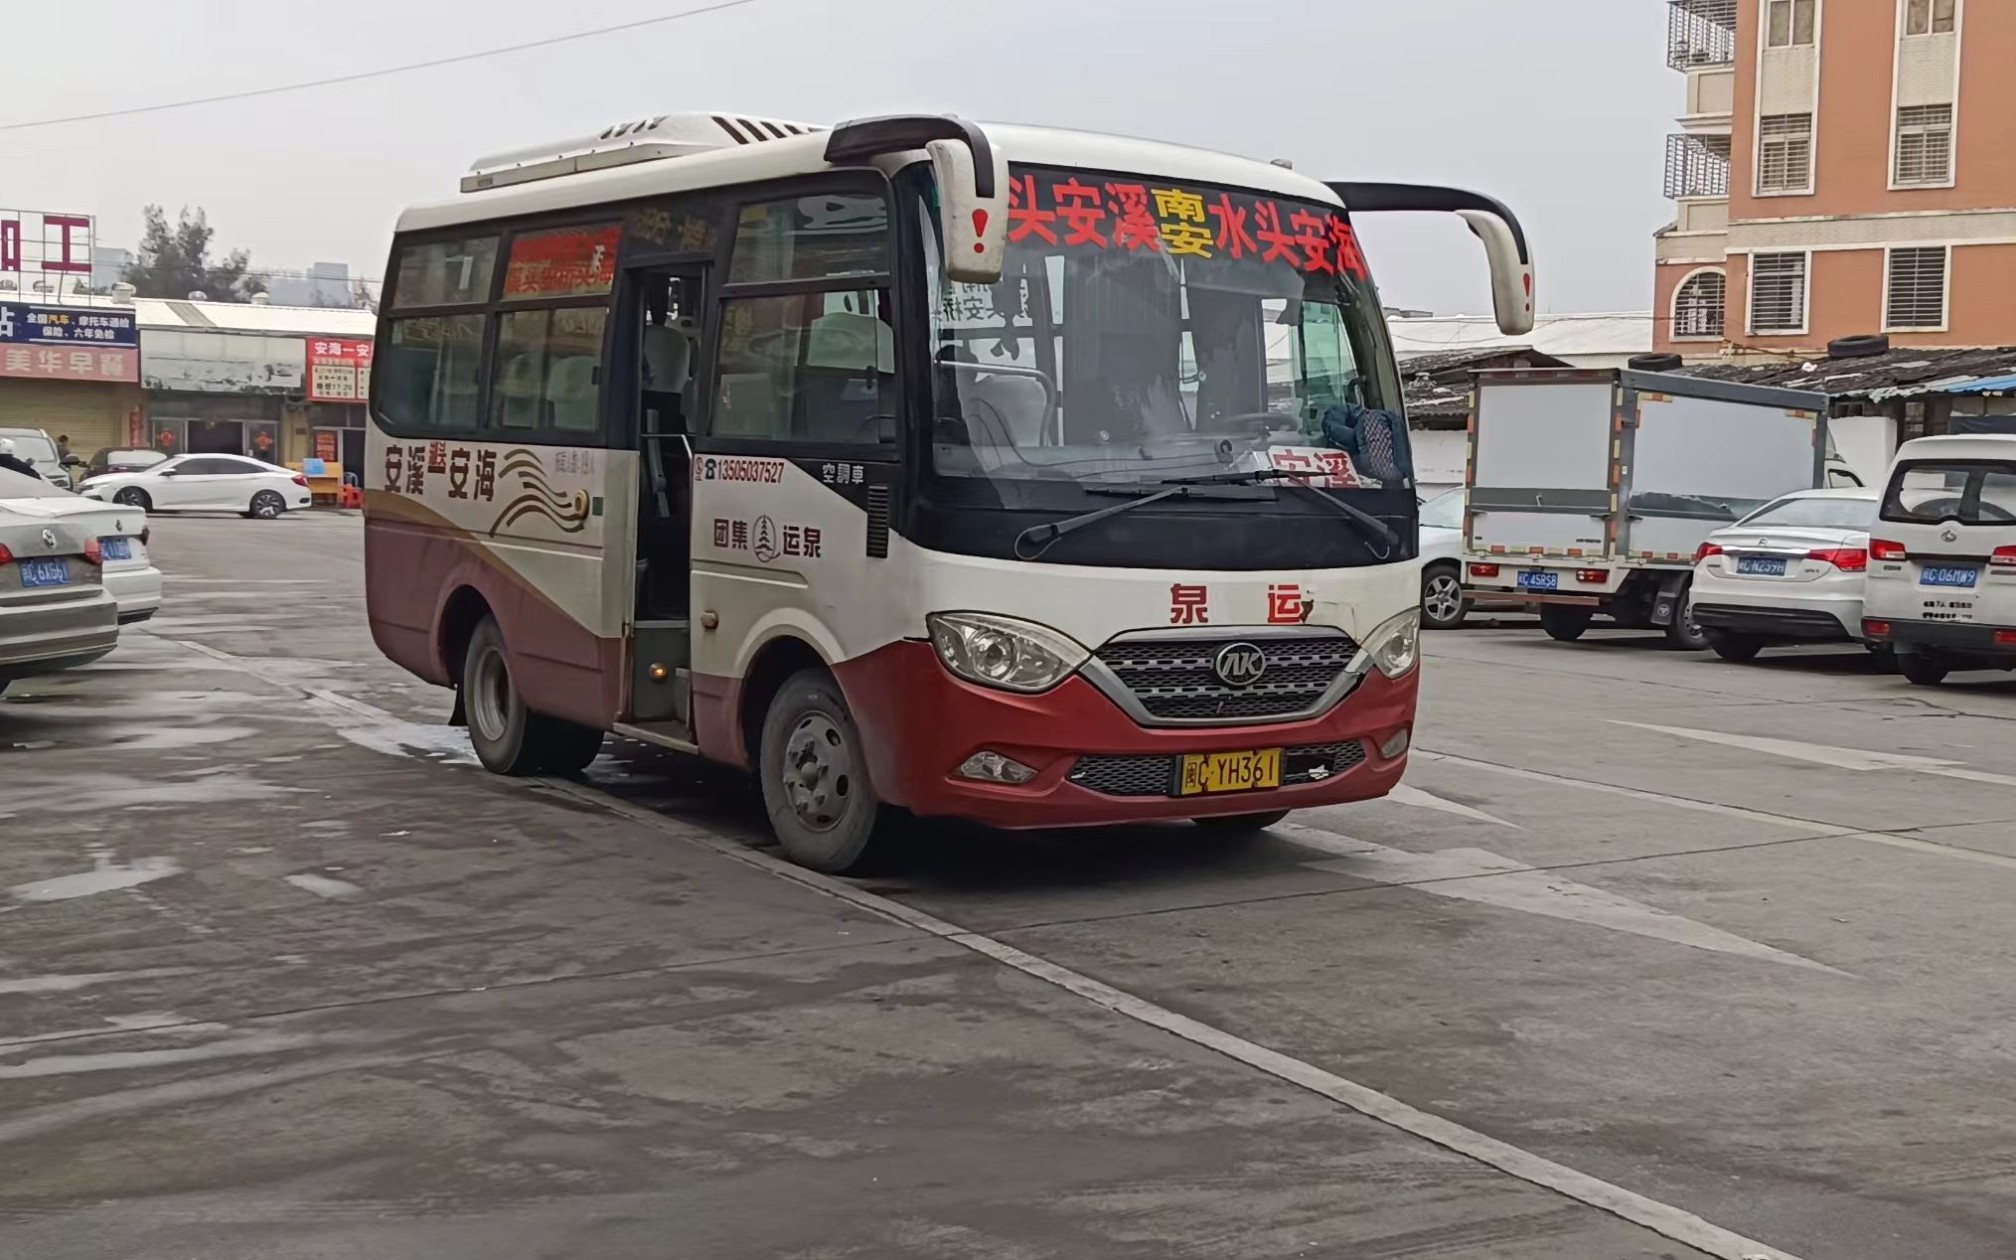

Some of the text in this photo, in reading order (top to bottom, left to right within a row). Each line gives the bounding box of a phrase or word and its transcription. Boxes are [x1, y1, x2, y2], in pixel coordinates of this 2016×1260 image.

[1150, 187, 1213, 259] 南安
[719, 459, 785, 483] 13505037527
[822, 463, 864, 485] 空調車
[1170, 583, 1302, 624] 泉 运
